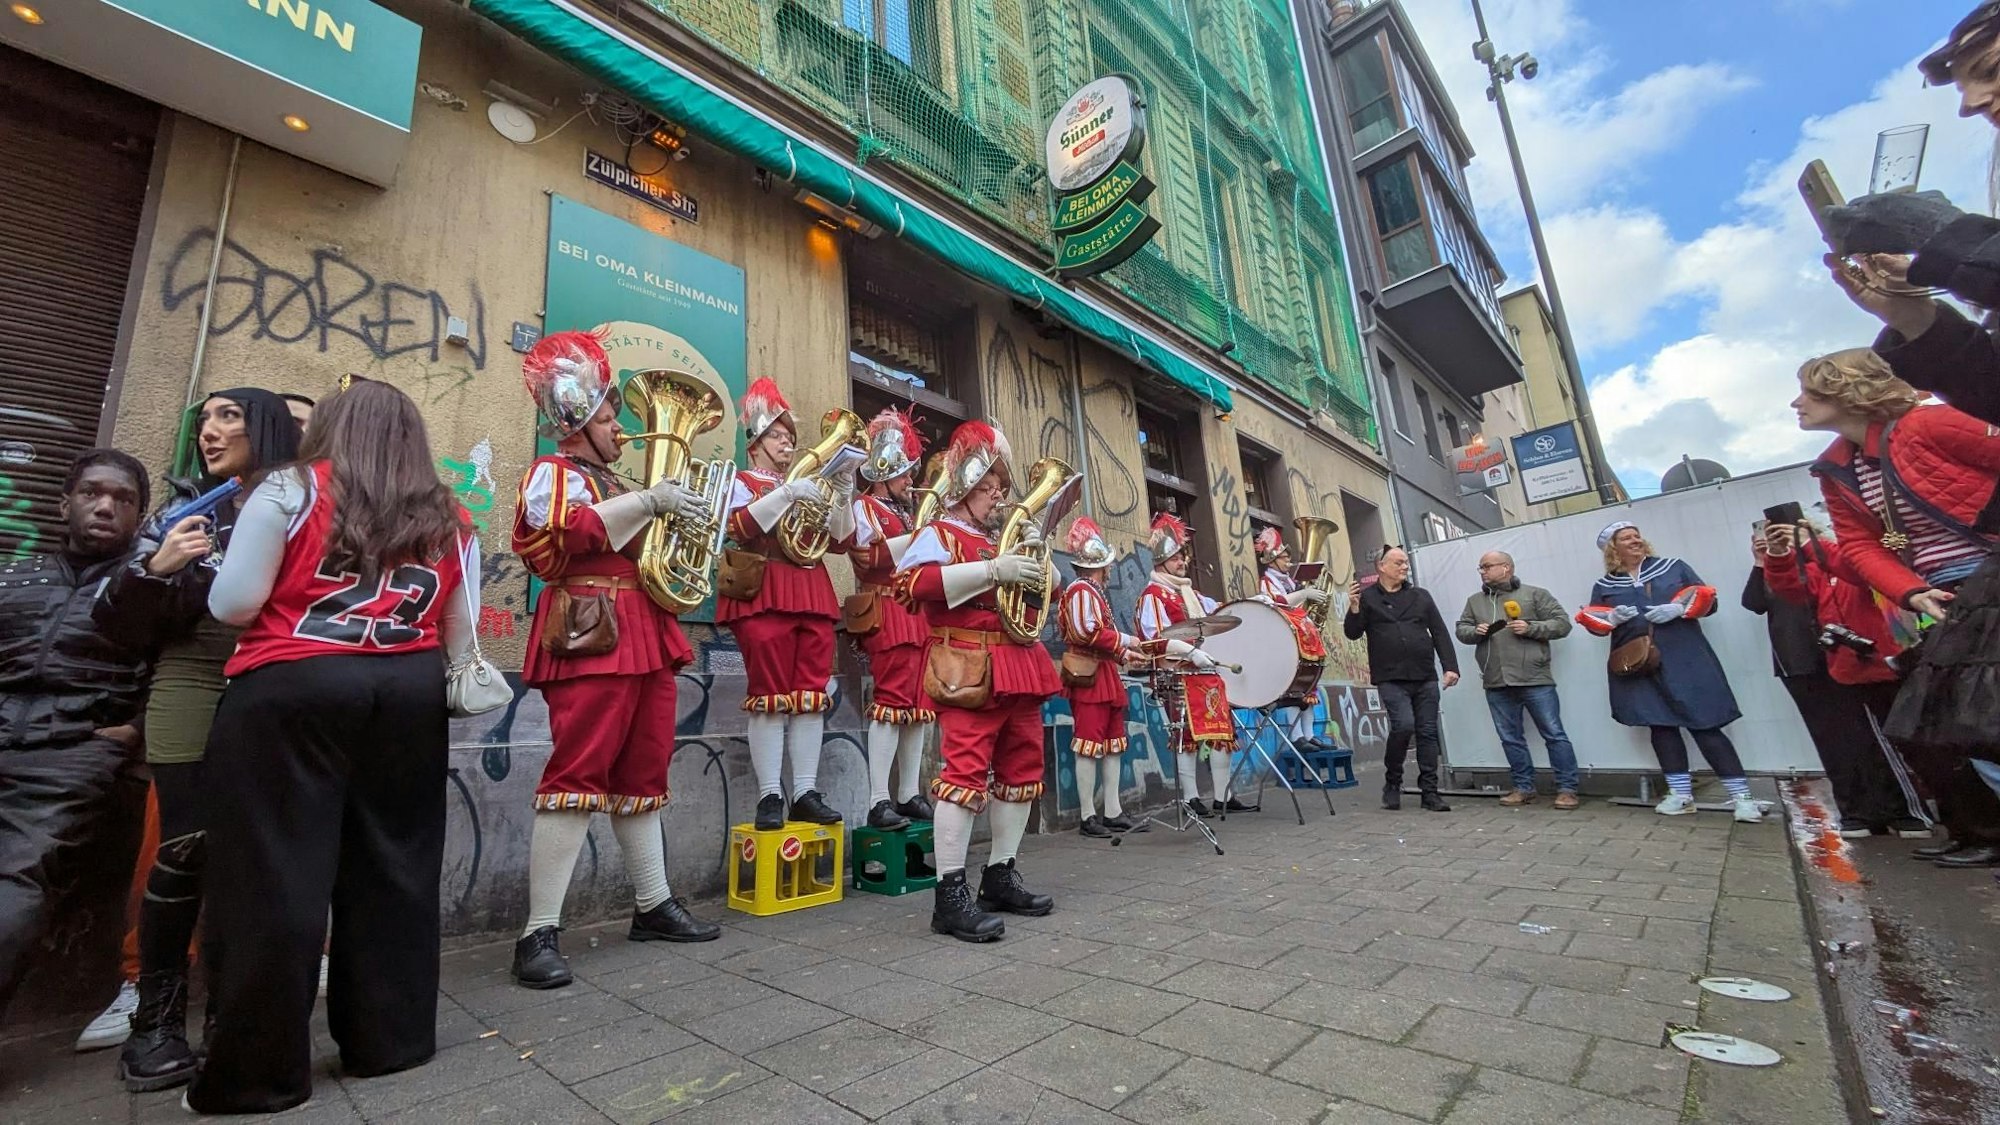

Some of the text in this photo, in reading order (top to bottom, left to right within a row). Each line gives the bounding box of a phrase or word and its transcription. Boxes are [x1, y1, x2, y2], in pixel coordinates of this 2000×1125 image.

[1060, 106, 1114, 151] Sünner
[588, 153, 696, 215] Zülpicher Str.
[1061, 175, 1133, 224] KLEINMANN
[1069, 175, 1121, 211] BEI OMA
[1066, 213, 1133, 258] Gaststätte
[558, 240, 739, 315] BEI OMA KLEINMANN
[293, 552, 441, 648] 23
